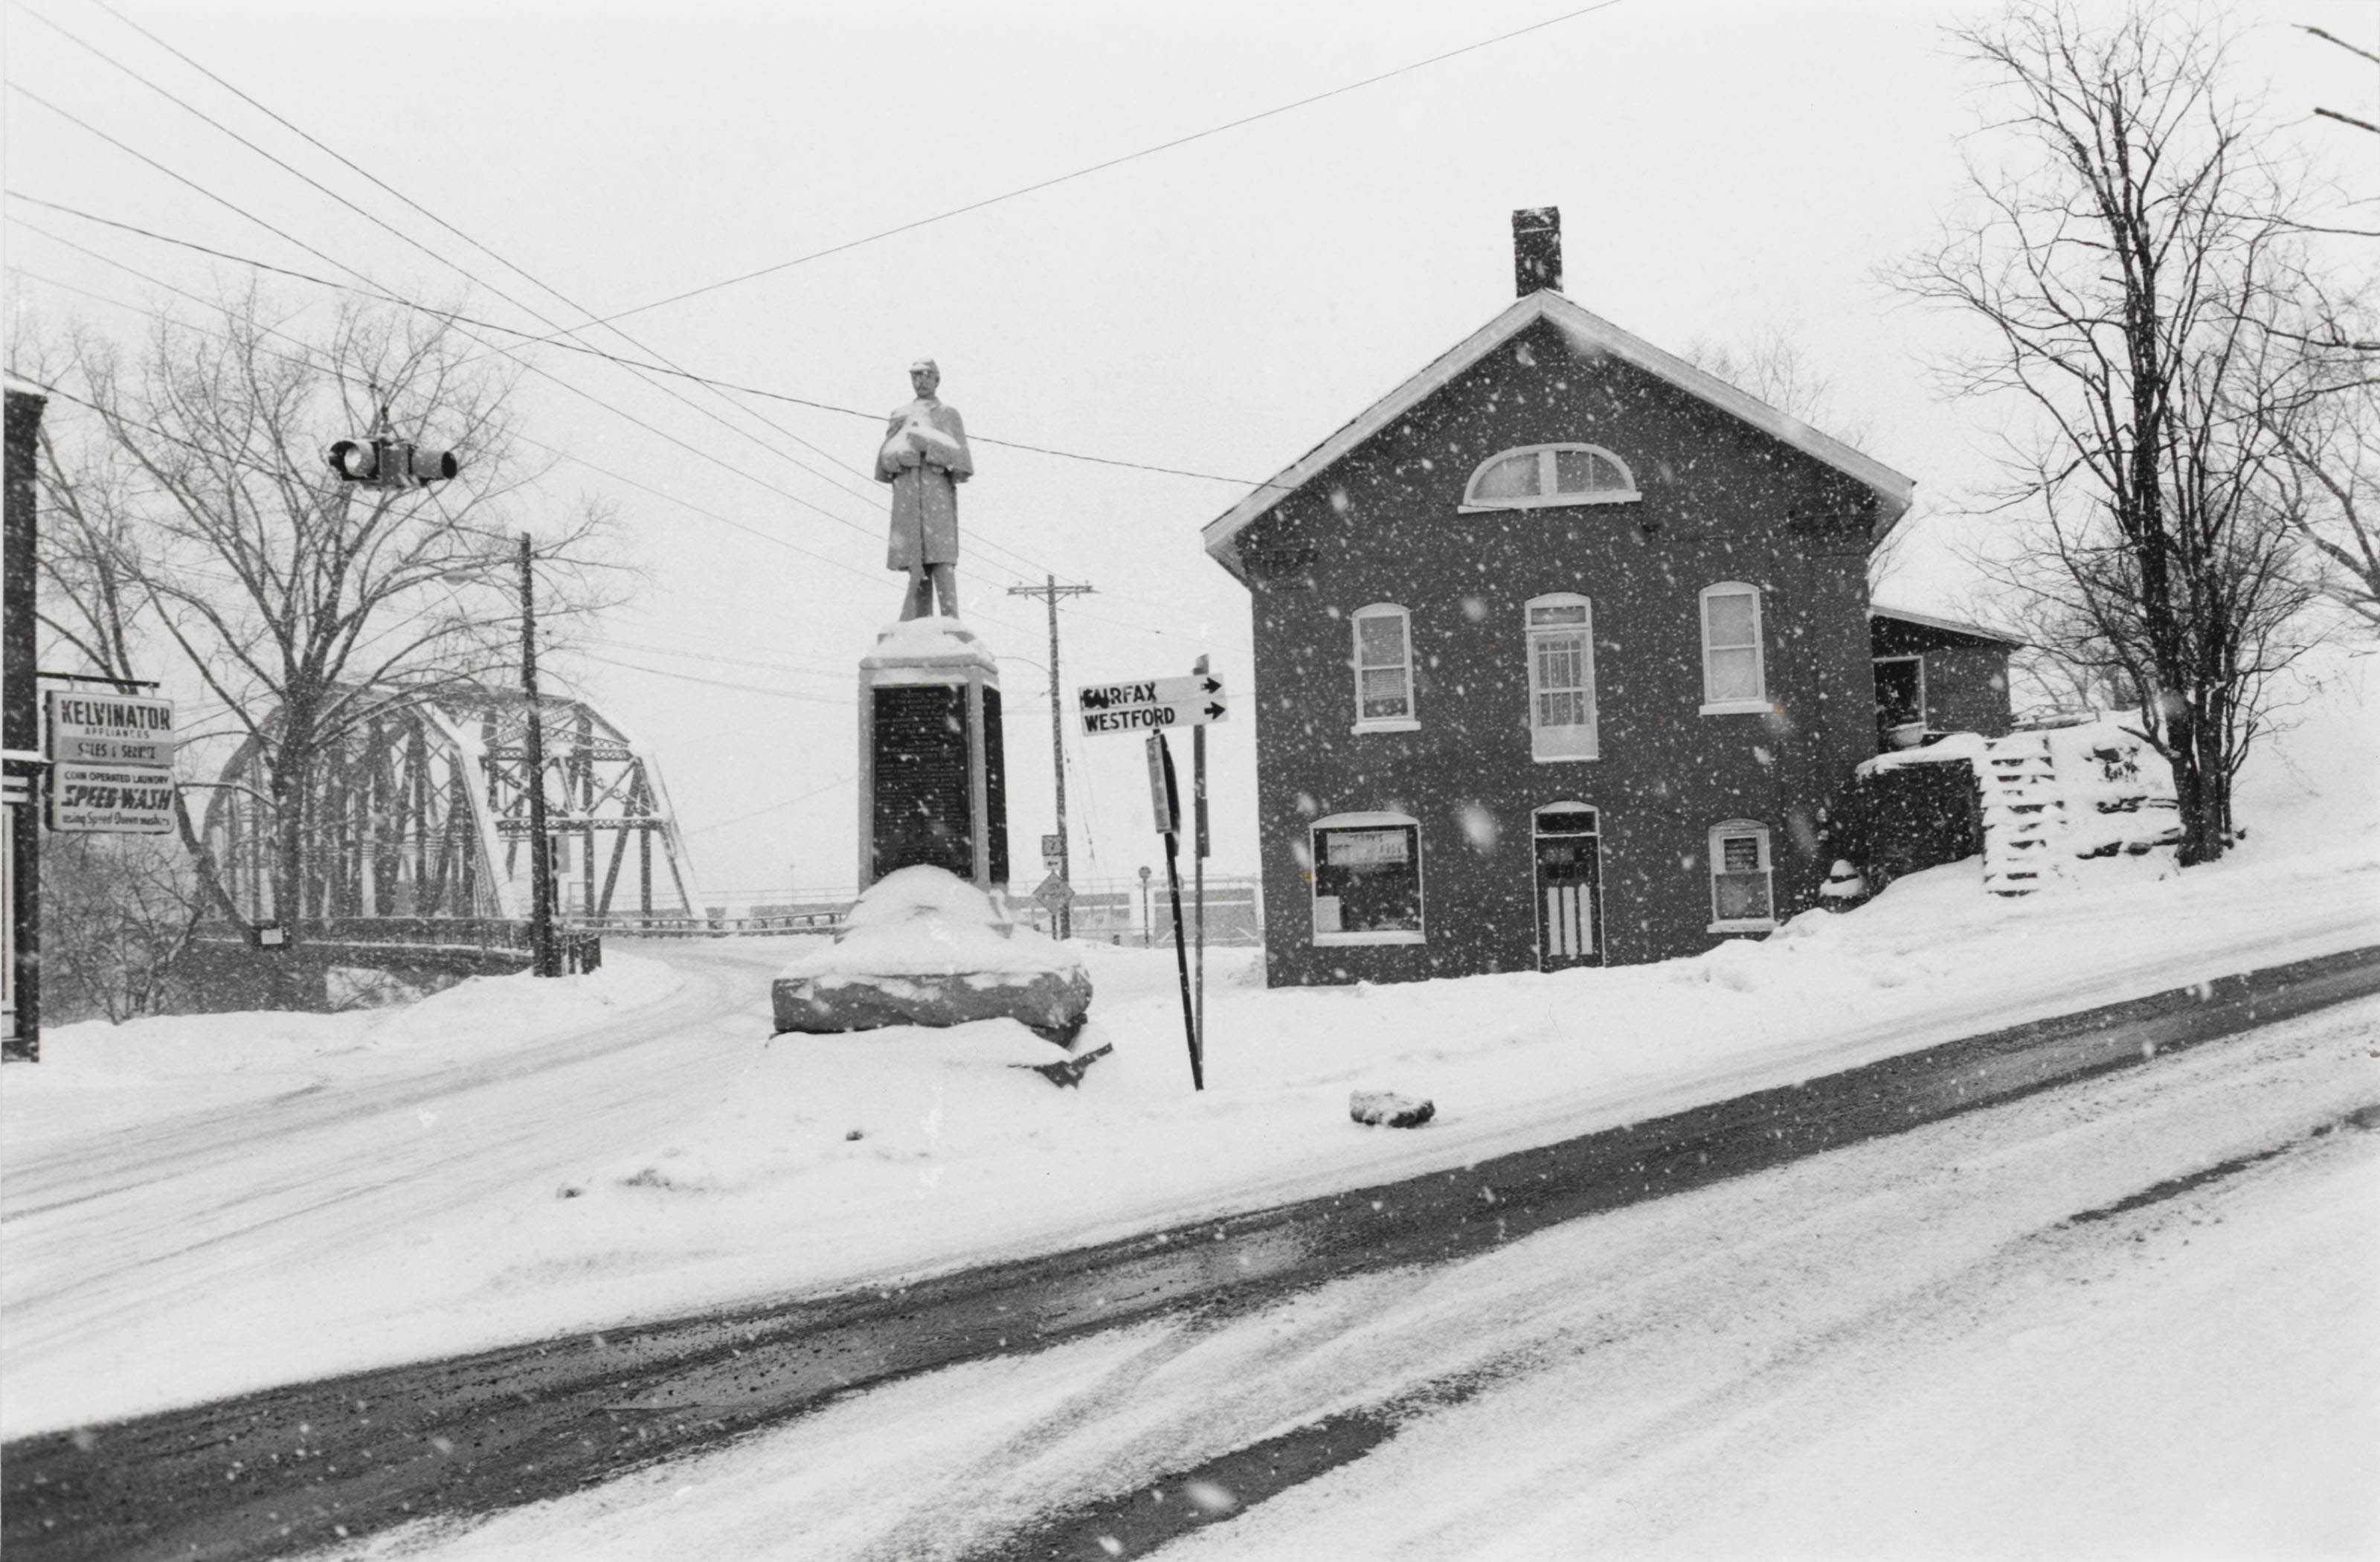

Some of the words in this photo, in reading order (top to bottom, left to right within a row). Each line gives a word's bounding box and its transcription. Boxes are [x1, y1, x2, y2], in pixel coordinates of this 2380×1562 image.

[61, 699, 171, 730] KELVINATOR
[1084, 707, 1175, 732] WESTFORD
[85, 727, 149, 739] APPLIANCES
[65, 771, 87, 780] COIN
[89, 772, 131, 783] OPERATED
[132, 774, 170, 784] LAUNDRY
